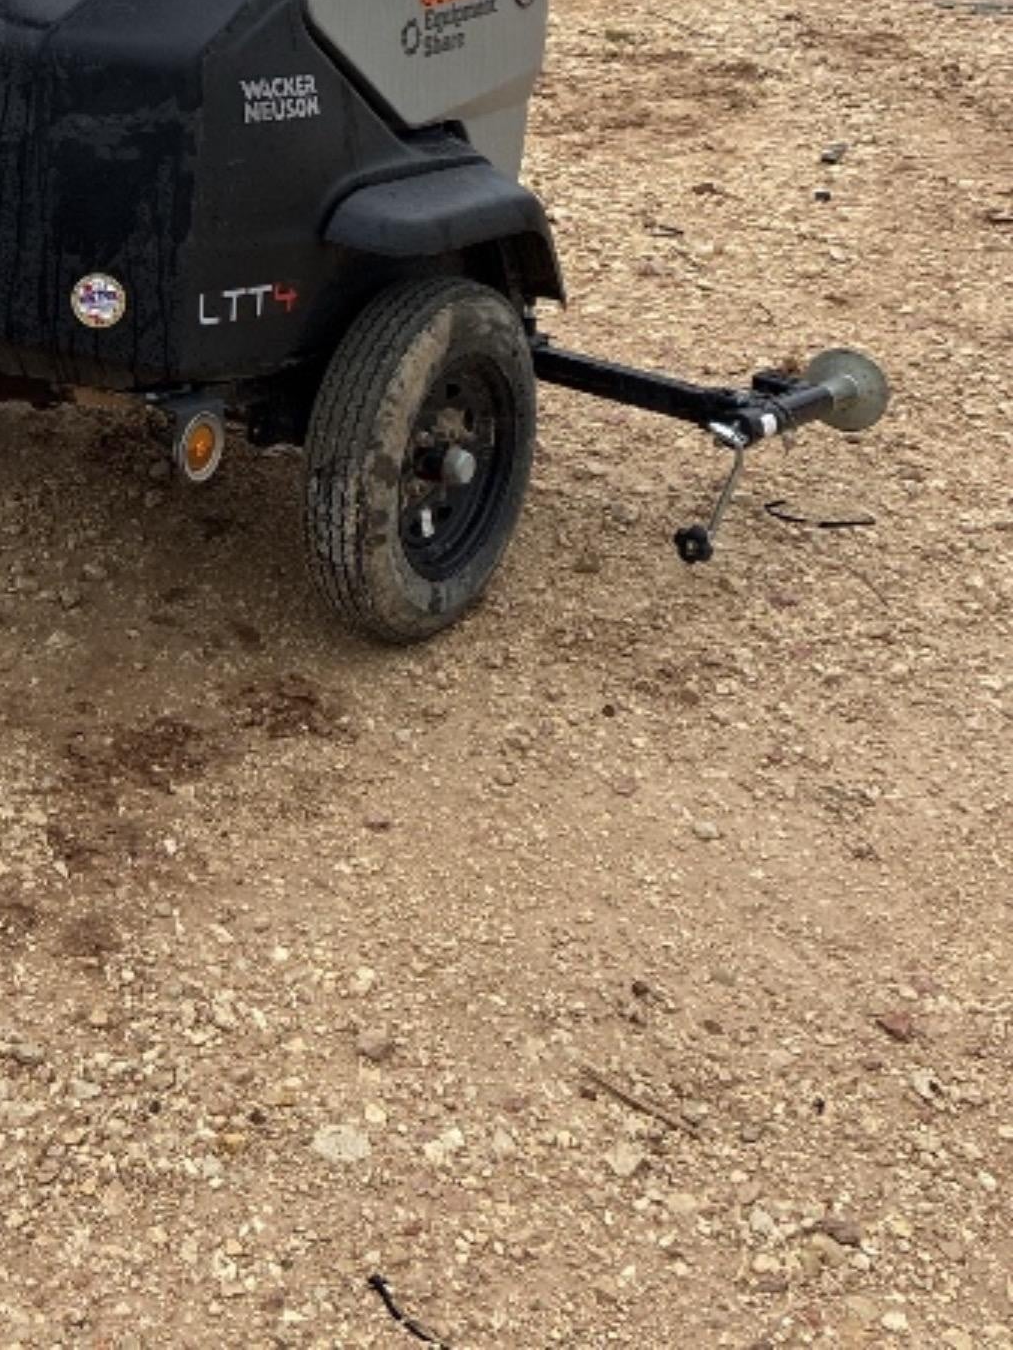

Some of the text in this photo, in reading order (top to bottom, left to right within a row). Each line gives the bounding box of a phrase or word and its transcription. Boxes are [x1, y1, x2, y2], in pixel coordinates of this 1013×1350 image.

[238, 74, 318, 100] WACKER
[244, 96, 321, 124] NEUSON
[199, 284, 298, 325] LTT4
